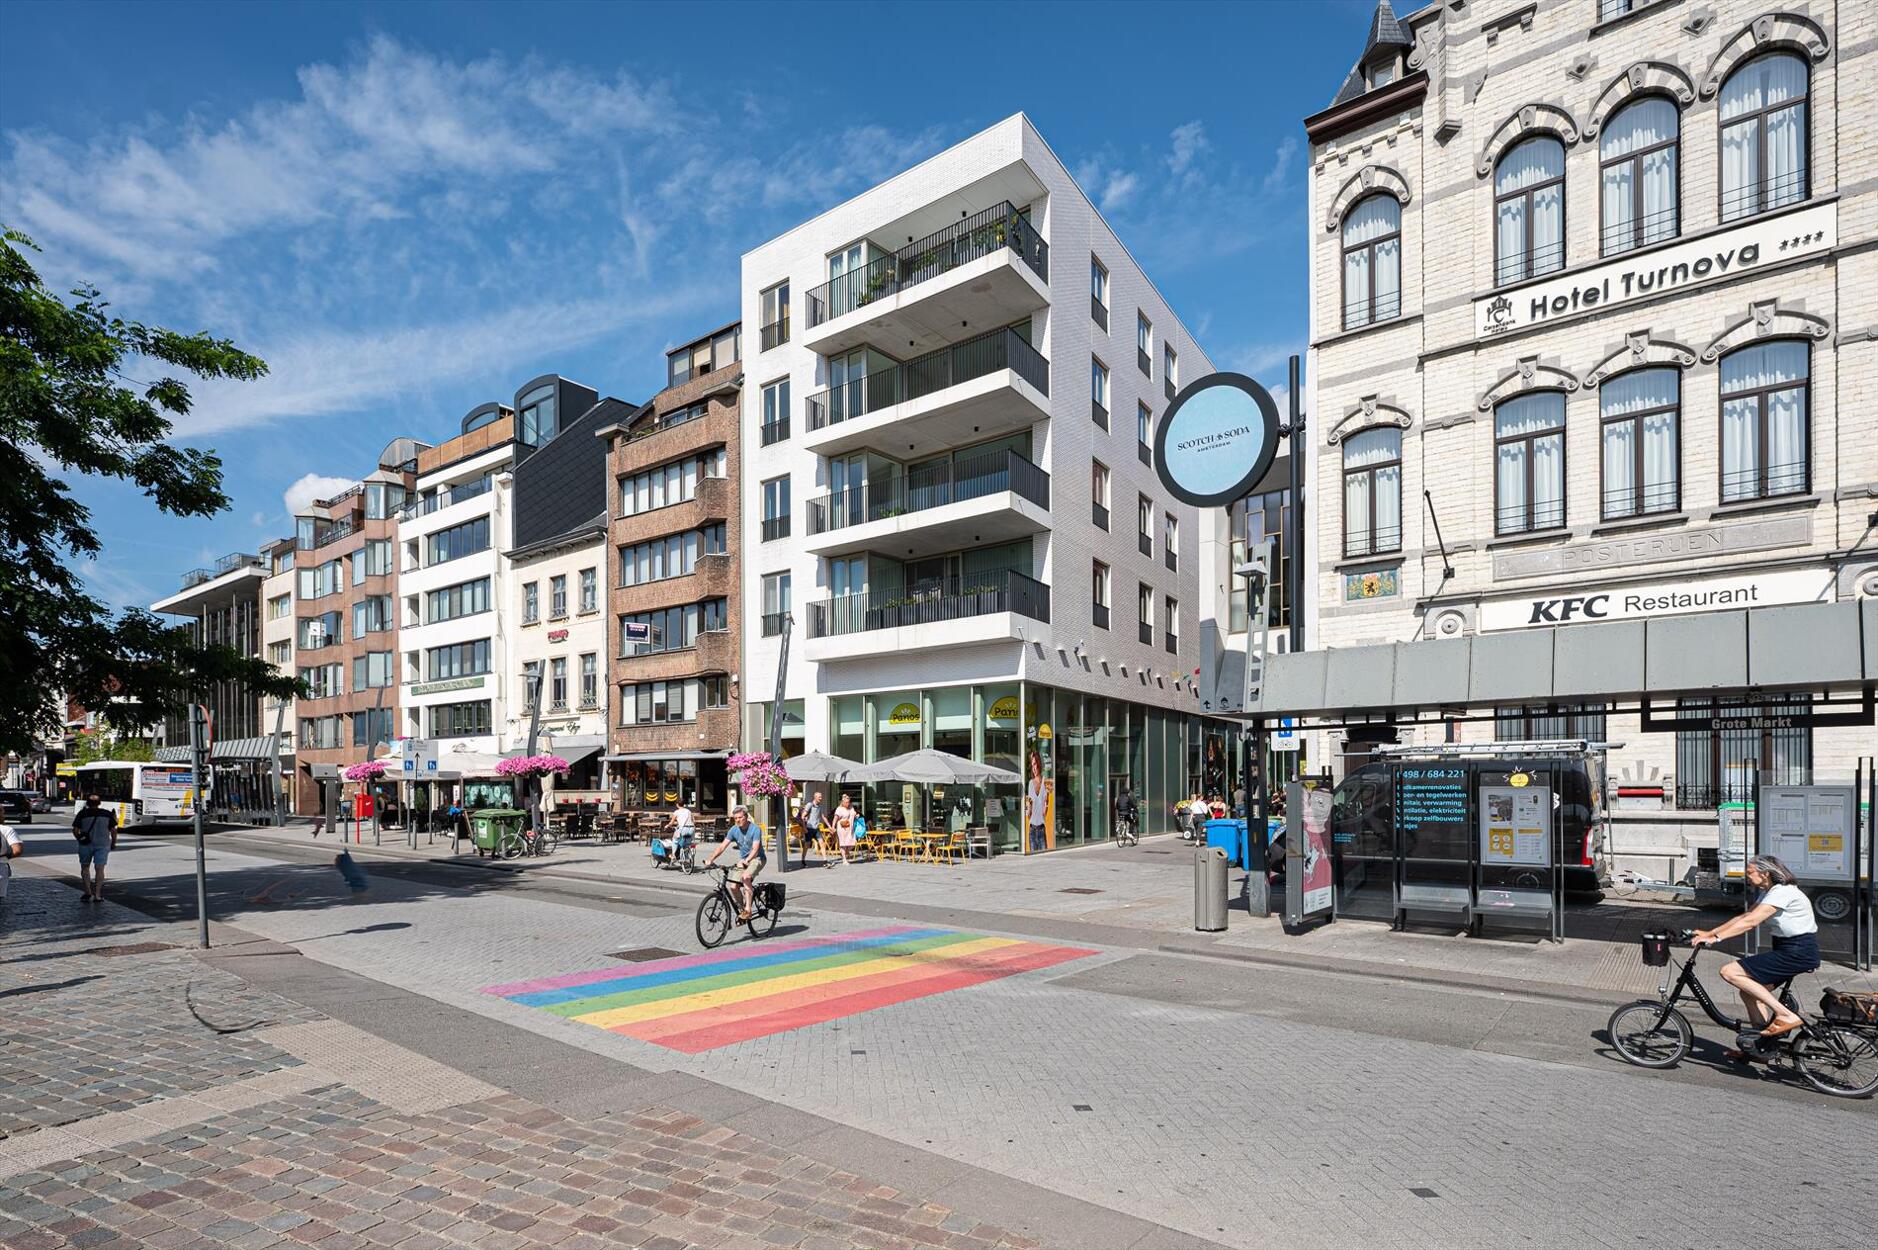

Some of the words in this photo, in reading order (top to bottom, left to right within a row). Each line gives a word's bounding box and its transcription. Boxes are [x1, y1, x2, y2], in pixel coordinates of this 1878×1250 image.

[1531, 278, 1609, 321] Hotel
[1621, 241, 1760, 297] Turnova
[1177, 434, 1214, 451] SCOTCH
[1223, 426, 1250, 439] SODA
[1197, 441, 1231, 452] AMSTERDAM
[1528, 594, 1610, 624] KFC
[1624, 584, 1758, 612] Restaurant
[994, 706, 1019, 716] Pan
[892, 713, 920, 722] Panos
[1711, 718, 1747, 729] Grote
[1750, 717, 1792, 728] Markt
[1427, 769, 1445, 778] 684
[1447, 769, 1464, 778] 221
